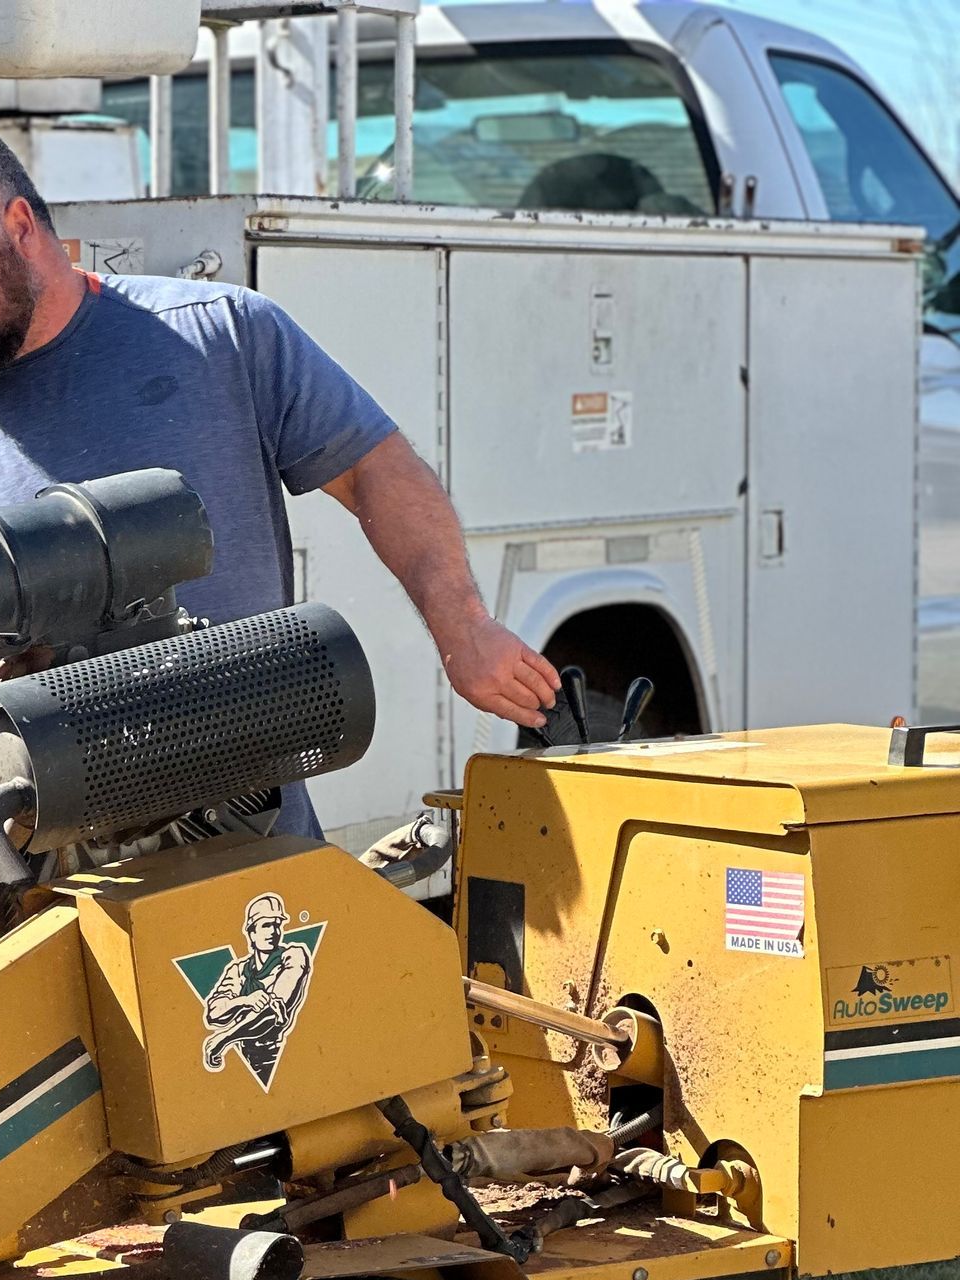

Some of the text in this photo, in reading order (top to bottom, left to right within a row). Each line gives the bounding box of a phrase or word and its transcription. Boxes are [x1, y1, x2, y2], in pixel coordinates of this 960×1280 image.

[730, 935, 800, 955] MADE IN USA
[832, 991, 950, 1020] AutoSweep
